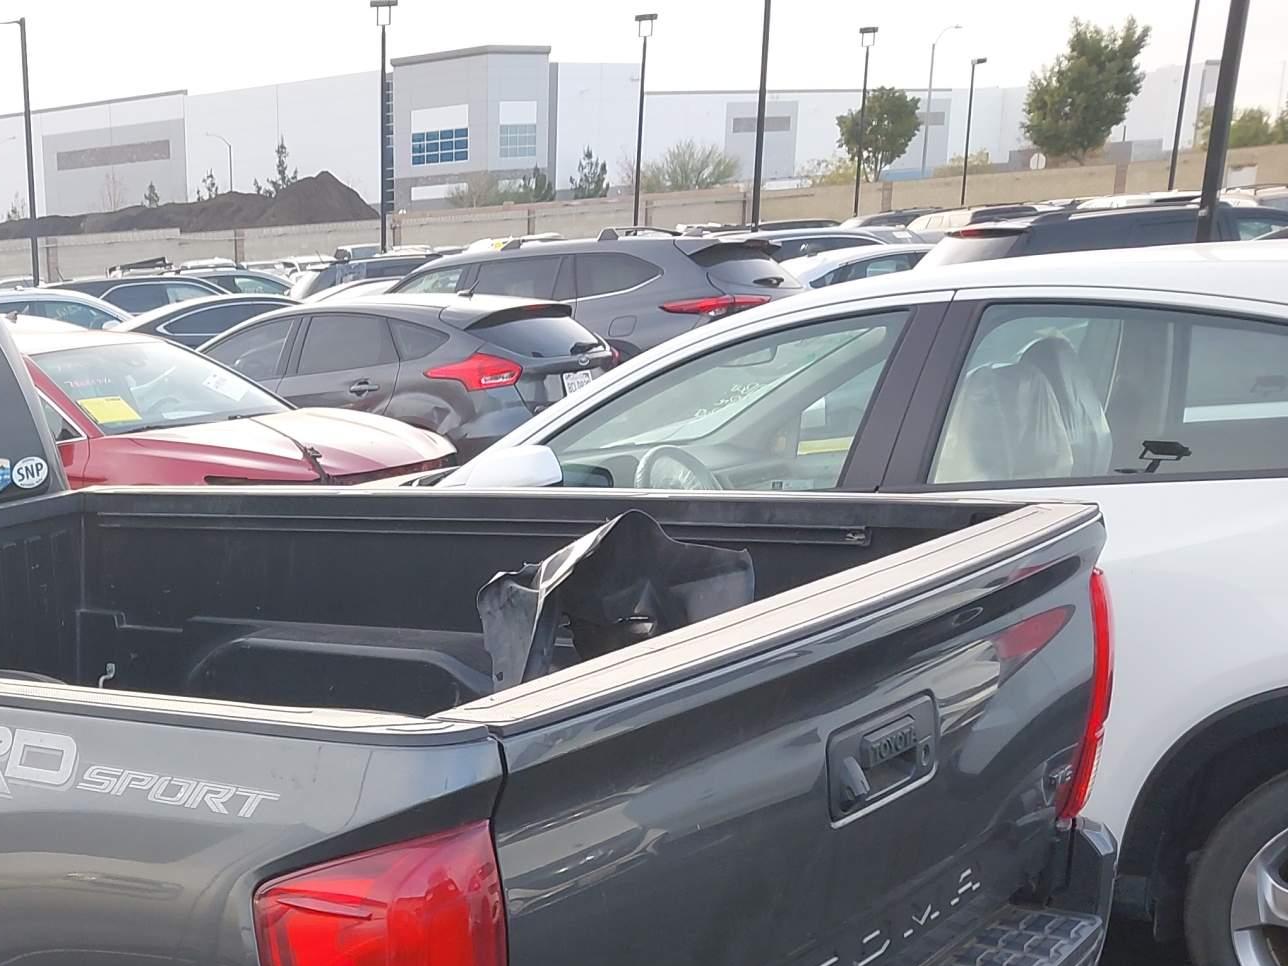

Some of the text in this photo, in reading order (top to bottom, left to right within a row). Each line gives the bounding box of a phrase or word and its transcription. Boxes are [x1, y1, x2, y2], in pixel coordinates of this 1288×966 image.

[16, 462, 44, 482] SNP
[870, 725, 918, 764] TOYOTA
[76, 764, 281, 819] SPORT
